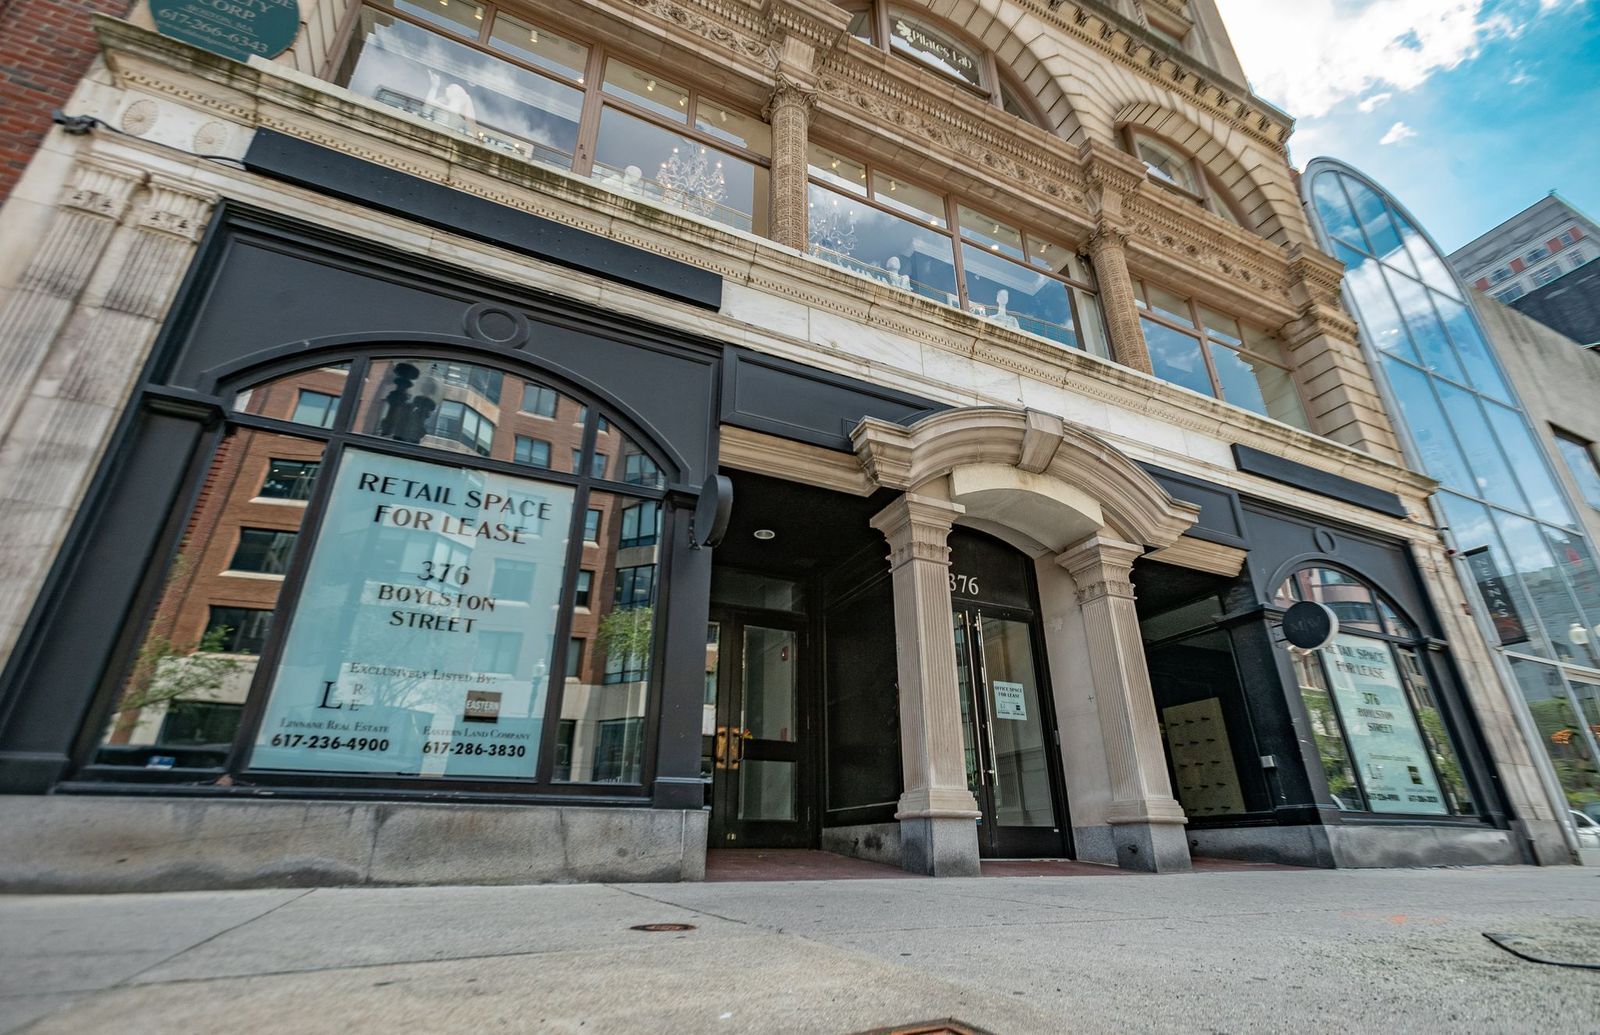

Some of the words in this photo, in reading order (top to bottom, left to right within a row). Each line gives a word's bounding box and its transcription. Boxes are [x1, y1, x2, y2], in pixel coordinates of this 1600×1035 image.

[158, 8, 269, 53] 617-266-6343
[912, 30, 950, 58] Pilates
[358, 472, 456, 506] RETAIL
[464, 490, 553, 521] SPACE
[373, 504, 434, 531] FOR
[441, 515, 528, 545] LEASE
[417, 560, 472, 587] 376
[949, 573, 980, 596] 376
[378, 584, 497, 612] BOYLSTON
[389, 610, 478, 634] STREET
[350, 662, 428, 679] EXCLUSIVELY
[432, 669, 472, 683] LISTED
[476, 673, 497, 685] BY:
[317, 680, 342, 710] L
[1362, 692, 1380, 706] 376
[271, 733, 390, 752] 617-236-4900
[422, 741, 526, 758] 617-286-3830
